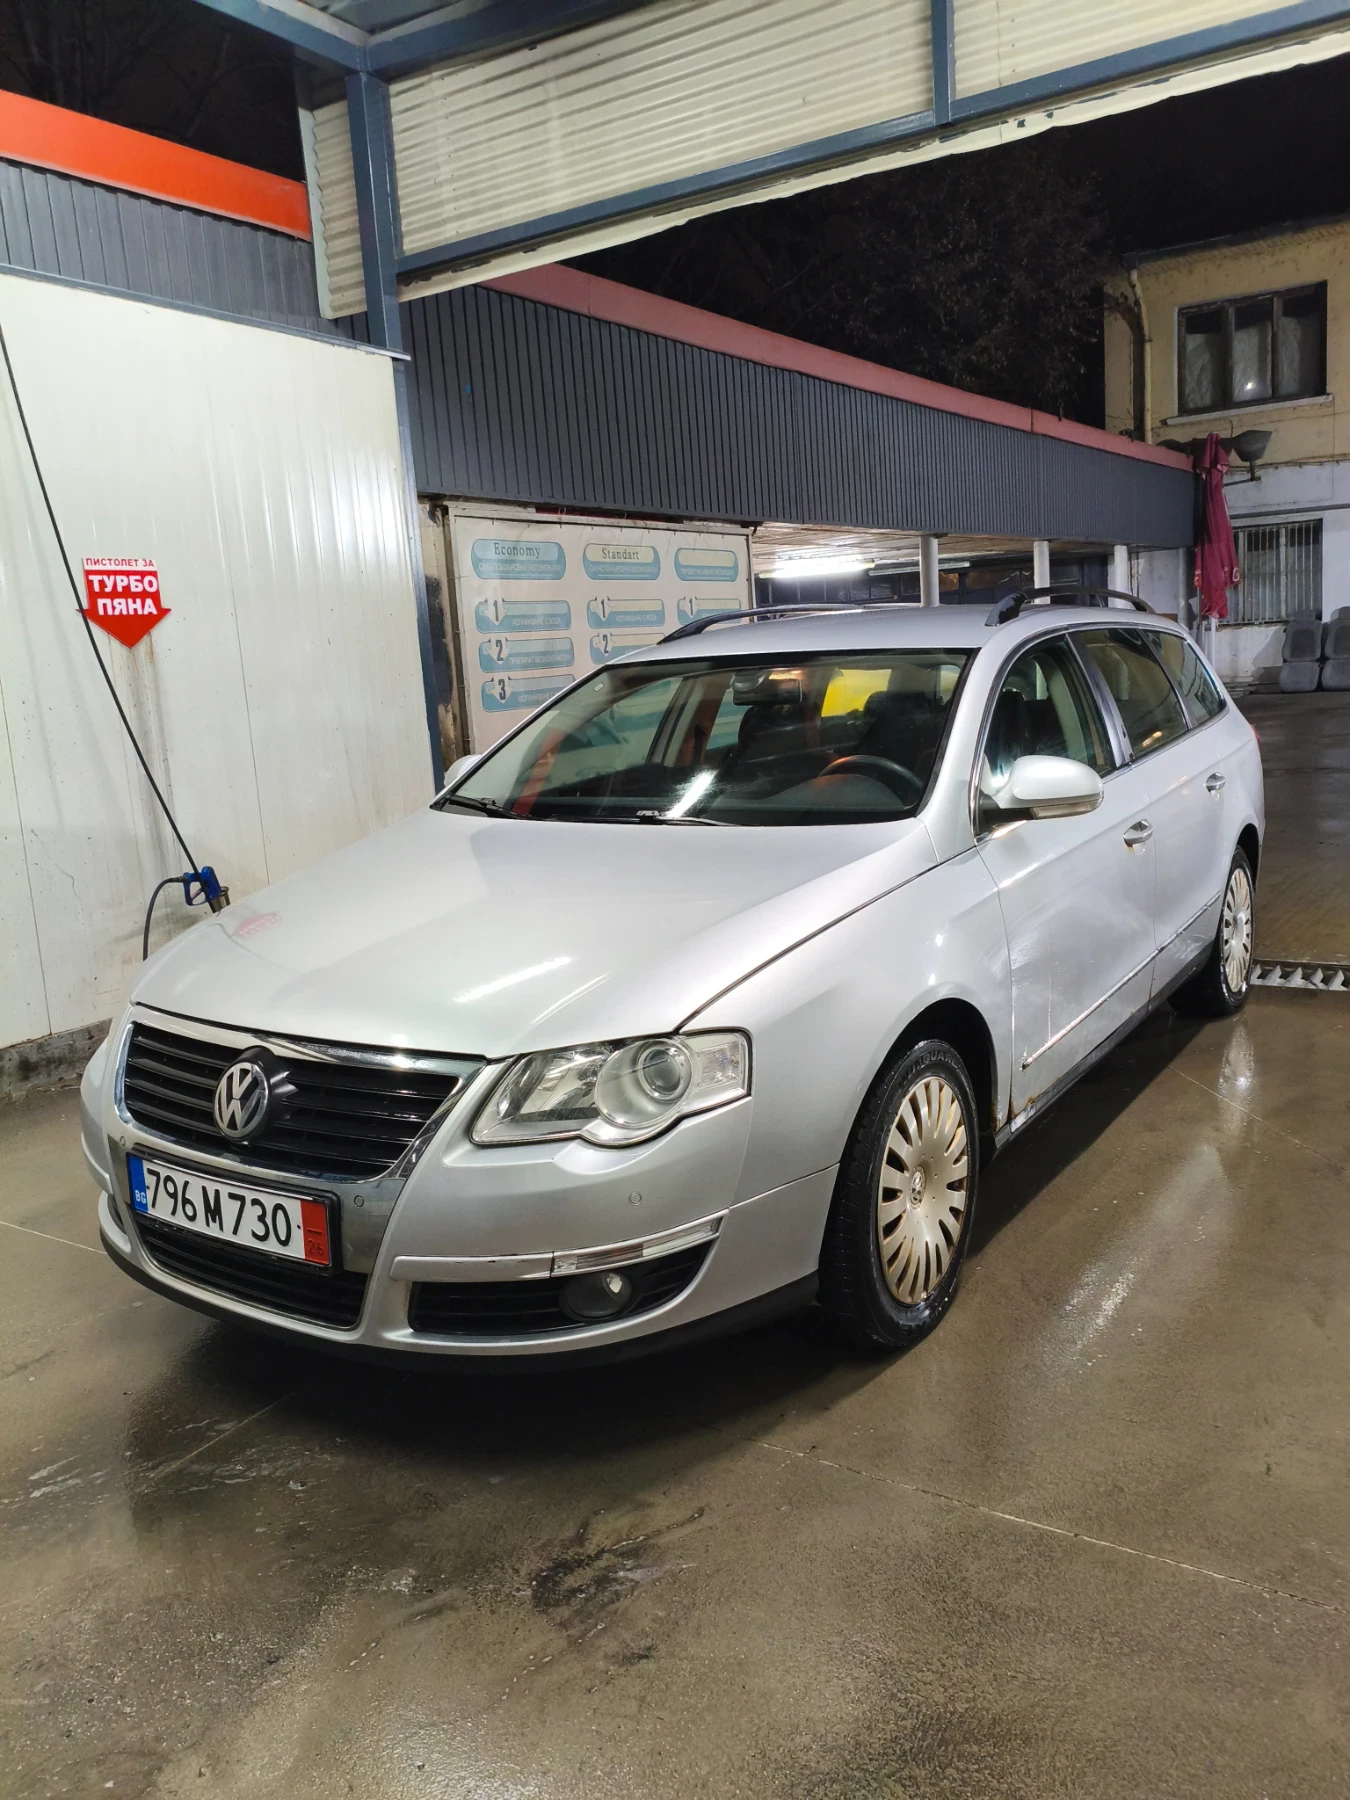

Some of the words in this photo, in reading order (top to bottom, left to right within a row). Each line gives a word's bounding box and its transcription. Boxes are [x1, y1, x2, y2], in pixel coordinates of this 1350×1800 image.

[493, 542, 541, 559] Economy
[601, 547, 640, 561] Standart
[85, 557, 140, 568] ПИСТОЛЕТ
[142, 559, 155, 568] ЗА
[88, 574, 159, 593] ТУРБО
[96, 597, 158, 616] ПЯНА
[492, 599, 500, 622] 1
[600, 598, 606, 619] 1
[688, 597, 694, 616] 1
[495, 639, 505, 662] 2
[602, 634, 609, 654] 2
[498, 678, 507, 701] 3
[135, 1189, 147, 1204] BG
[146, 1167, 292, 1247] 796M730
[307, 1238, 325, 1257] 26
